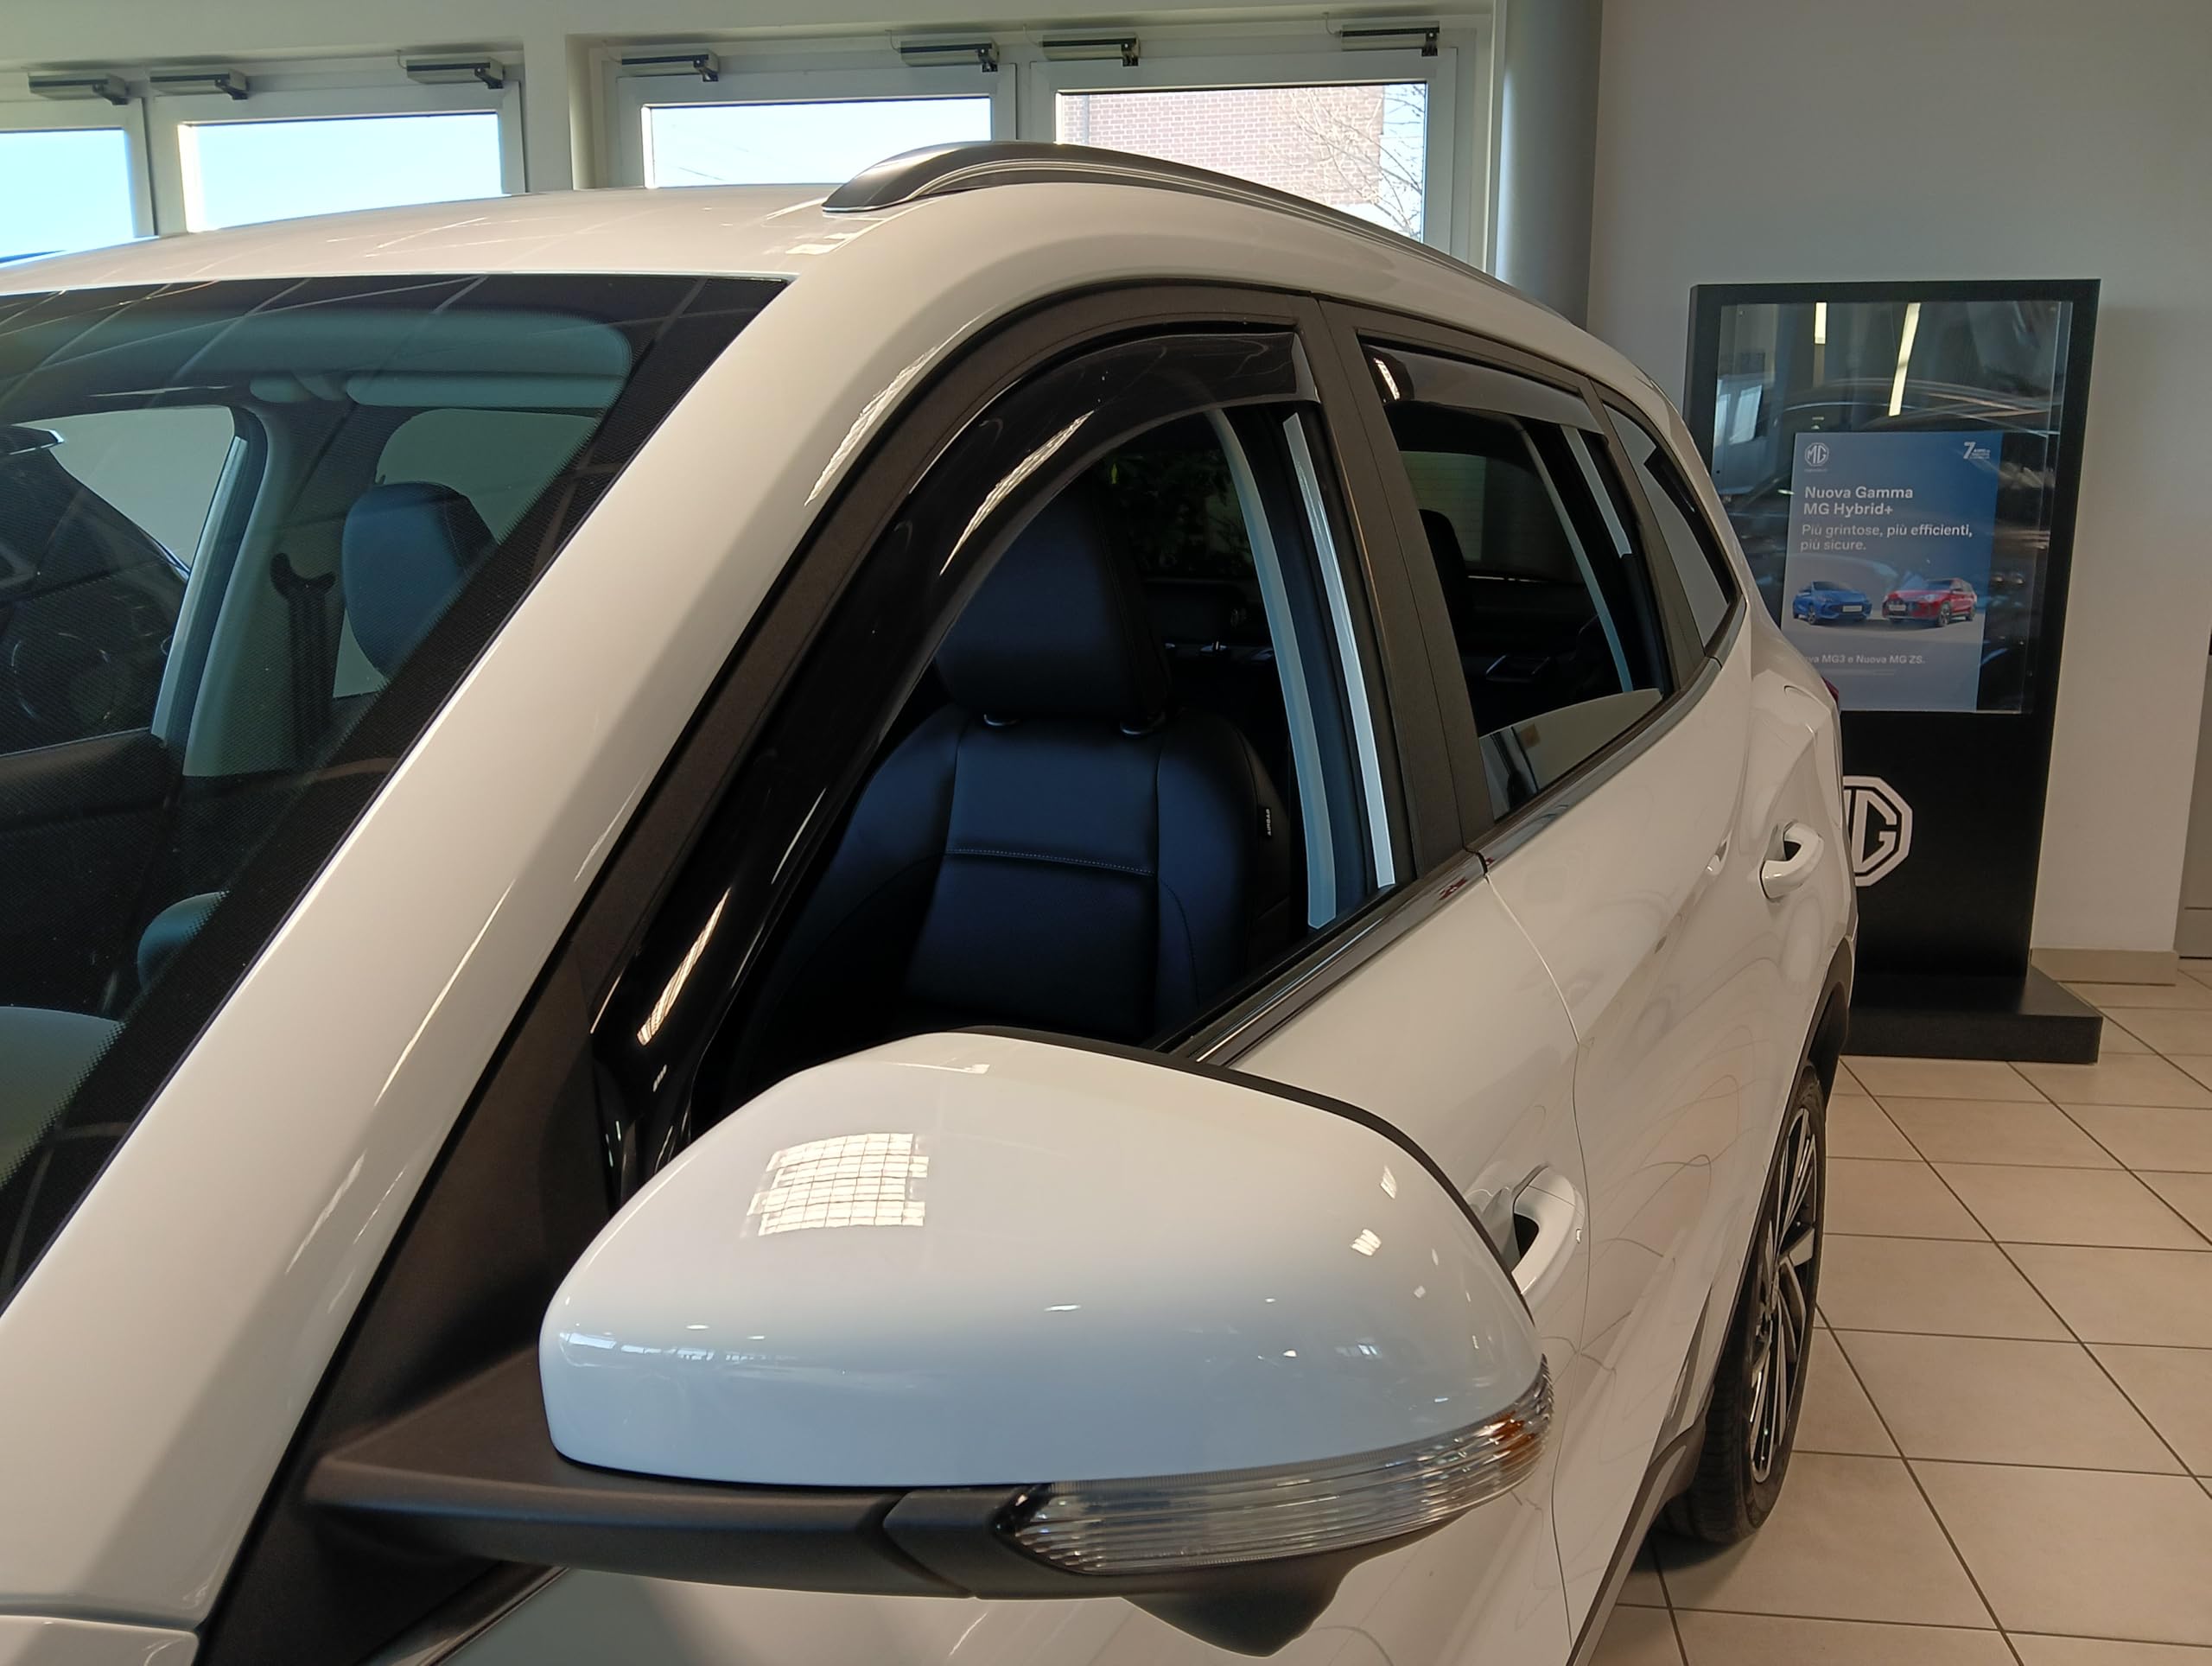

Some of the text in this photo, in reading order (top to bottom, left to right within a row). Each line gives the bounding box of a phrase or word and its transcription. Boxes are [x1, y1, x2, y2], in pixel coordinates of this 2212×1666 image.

[1806, 443, 1828, 465] MG
[1963, 442, 1976, 460] 7
[1805, 486, 1913, 499] Nuova Gamma
[1803, 503, 1893, 518] MG Hybrid+
[1802, 524, 1973, 537] Più grintose, più efficienti,
[1800, 540, 1866, 552] più sicure.
[1821, 654, 1846, 664] MG3
[1856, 655, 1887, 664] Nuova
[1890, 655, 1907, 664] MG
